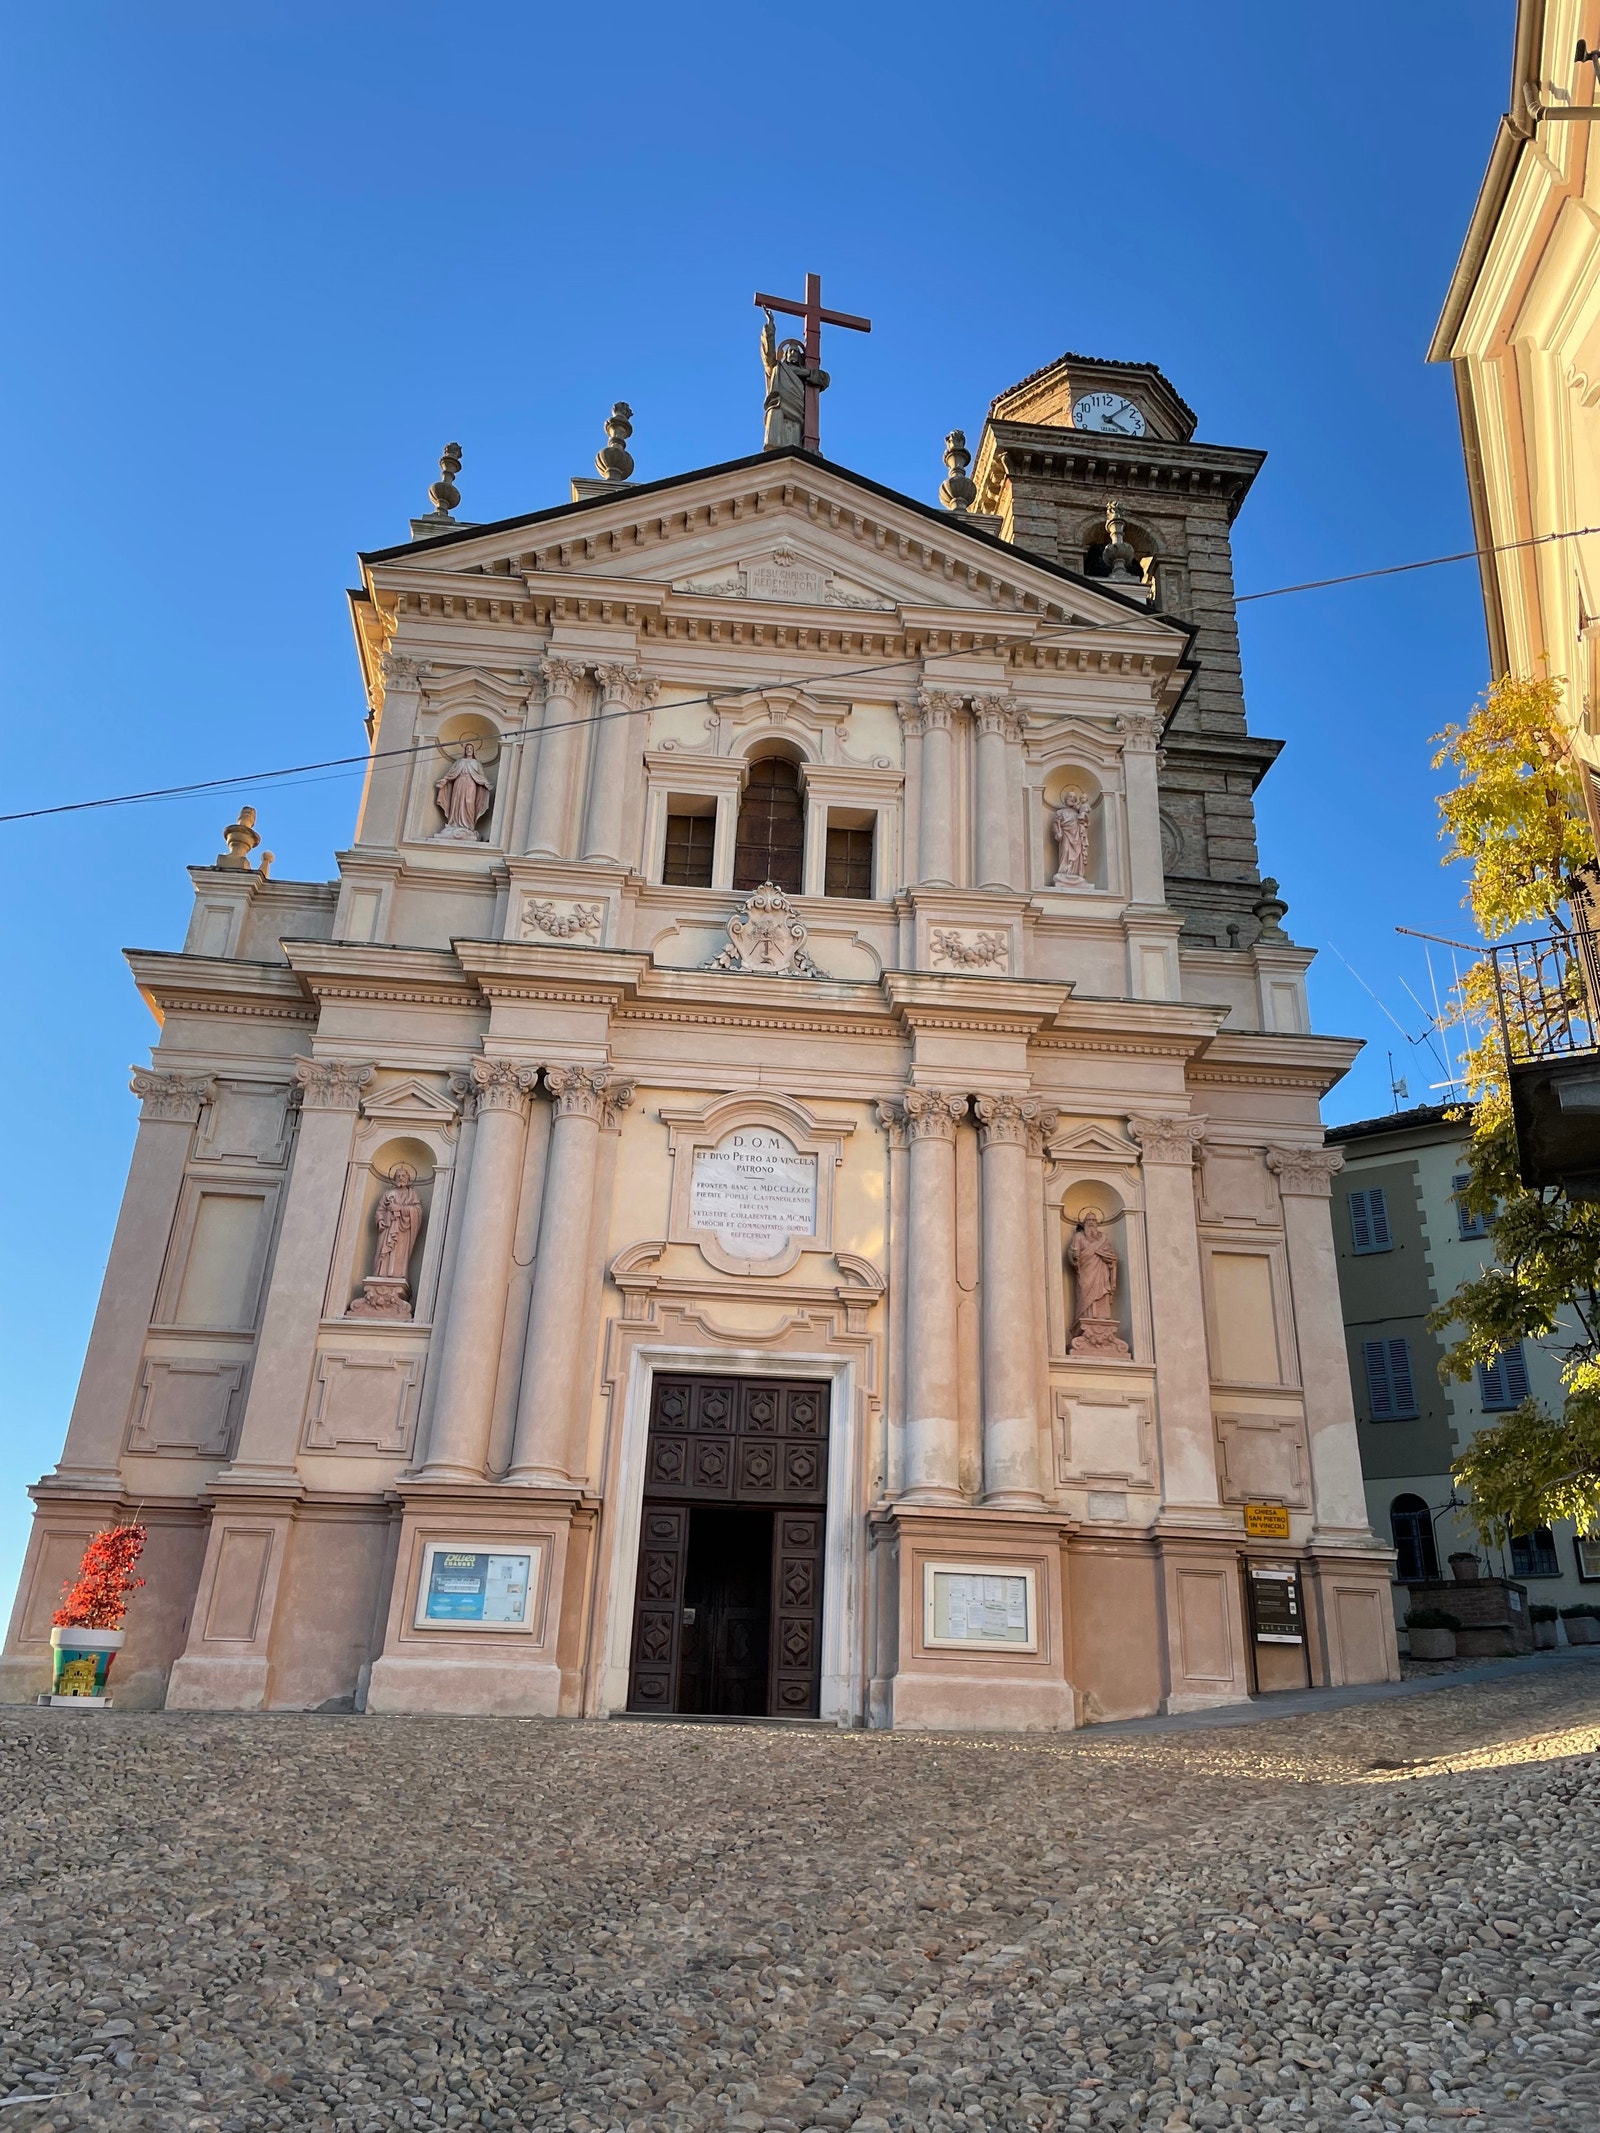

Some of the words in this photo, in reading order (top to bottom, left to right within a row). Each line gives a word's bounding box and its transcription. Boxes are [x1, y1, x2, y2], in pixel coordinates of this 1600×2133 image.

[1092, 397, 1100, 407] 11
[1103, 396, 1113, 406] 12
[1081, 403, 1090, 413] 10
[1076, 413, 1083, 422] 9
[1129, 409, 1136, 418] 2
[1135, 420, 1141, 429] 3
[755, 568, 777, 578] JESU
[780, 570, 816, 581] CHRISTO
[780, 1158, 815, 1166] VINCULA
[737, 1165, 774, 1174] PATRONO
[760, 1185, 810, 1194] MDCCLXXIX
